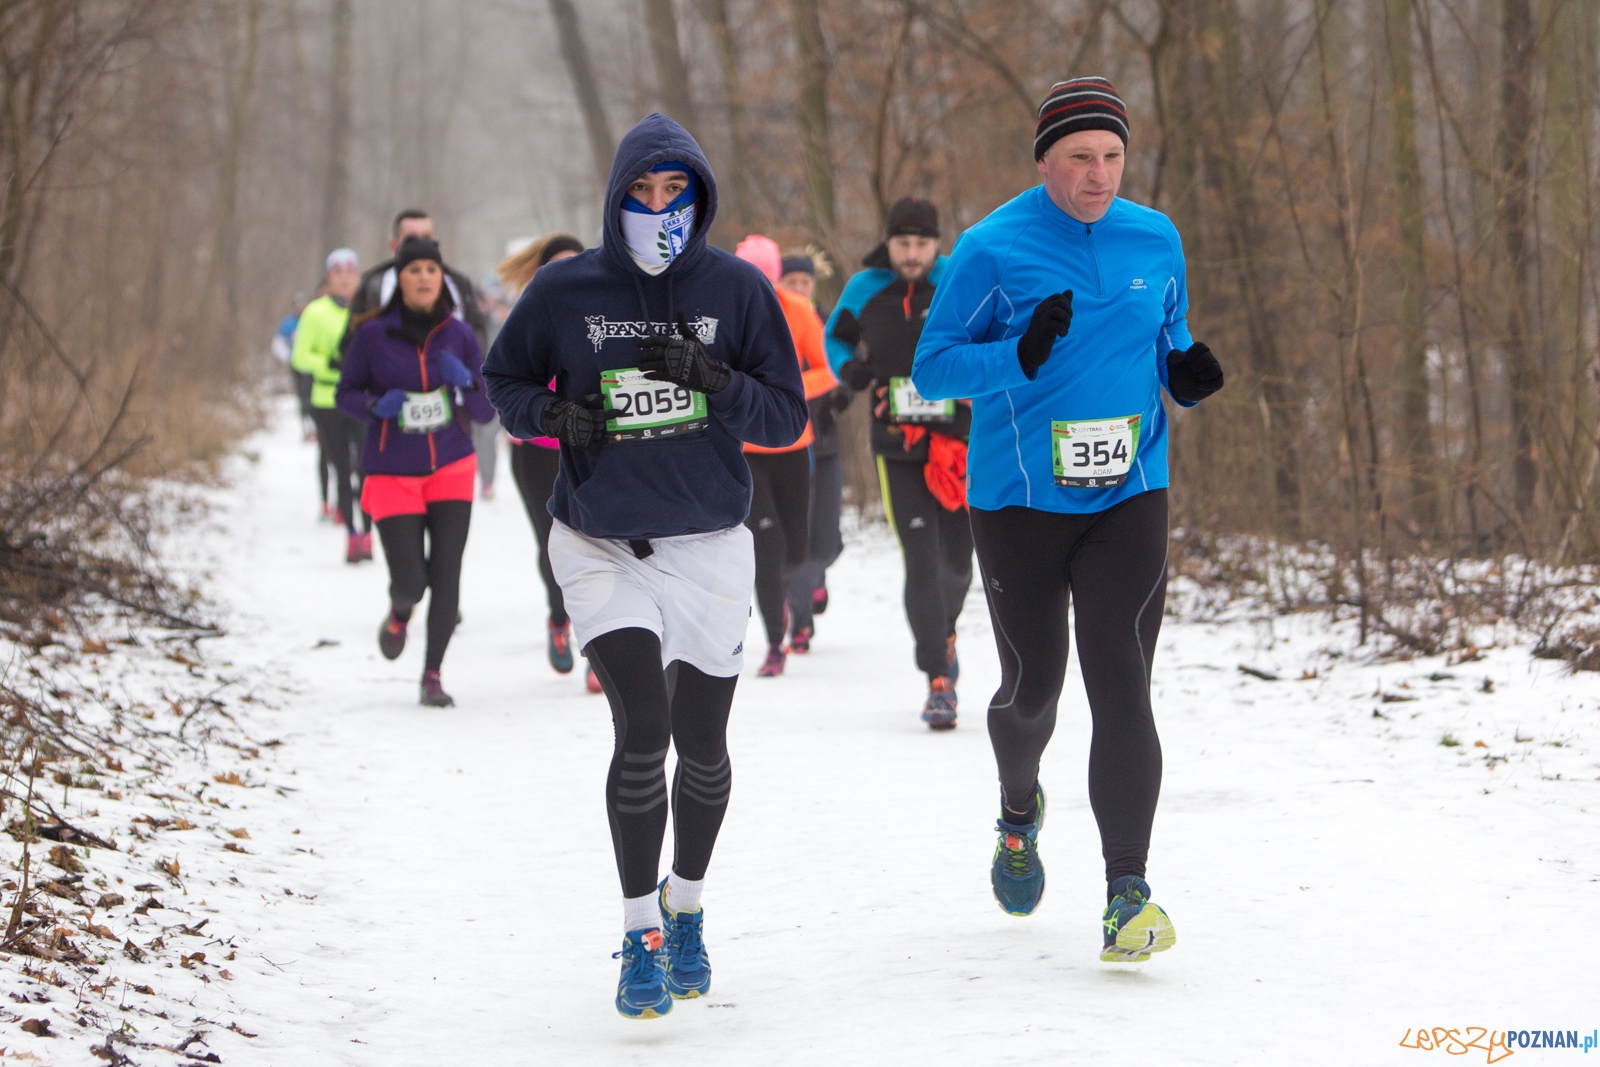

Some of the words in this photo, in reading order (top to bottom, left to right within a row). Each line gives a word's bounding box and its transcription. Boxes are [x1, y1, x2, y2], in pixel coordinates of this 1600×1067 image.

[667, 218, 681, 227] KKS
[615, 386, 692, 418] 2059
[1072, 438, 1128, 468] 354
[1093, 468, 1113, 476] ADAM
